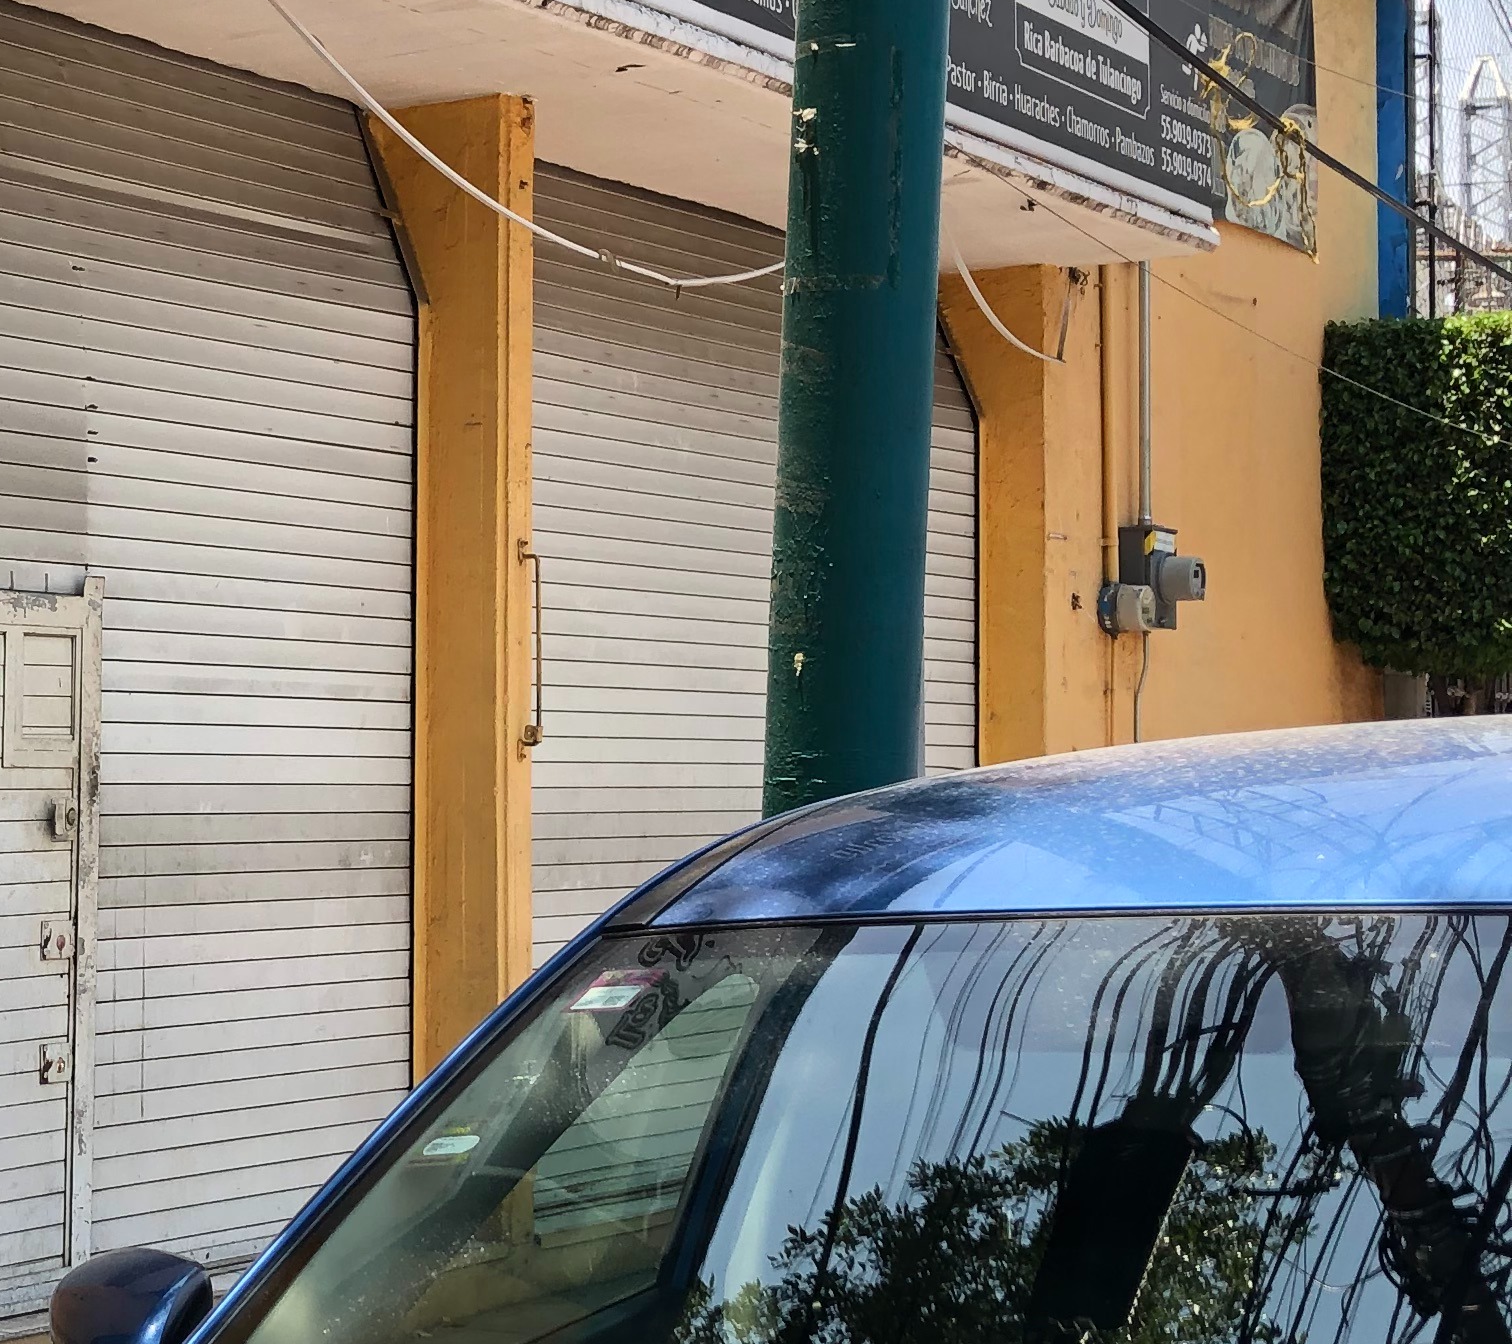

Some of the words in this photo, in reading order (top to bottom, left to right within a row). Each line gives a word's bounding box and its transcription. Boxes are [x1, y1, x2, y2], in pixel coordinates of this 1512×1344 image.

[1080, 0, 1086, 29] y
[1023, 20, 1044, 57] Rica
[1044, 29, 1085, 76] Barbacoa
[1085, 48, 1097, 81] de
[1097, 53, 1143, 106] Tulancingo
[983, 69, 1008, 107] Birria
[1014, 83, 1060, 128] Huaraches
[1066, 105, 1110, 149] Chamorros
[1115, 126, 1156, 167] Pambazos
